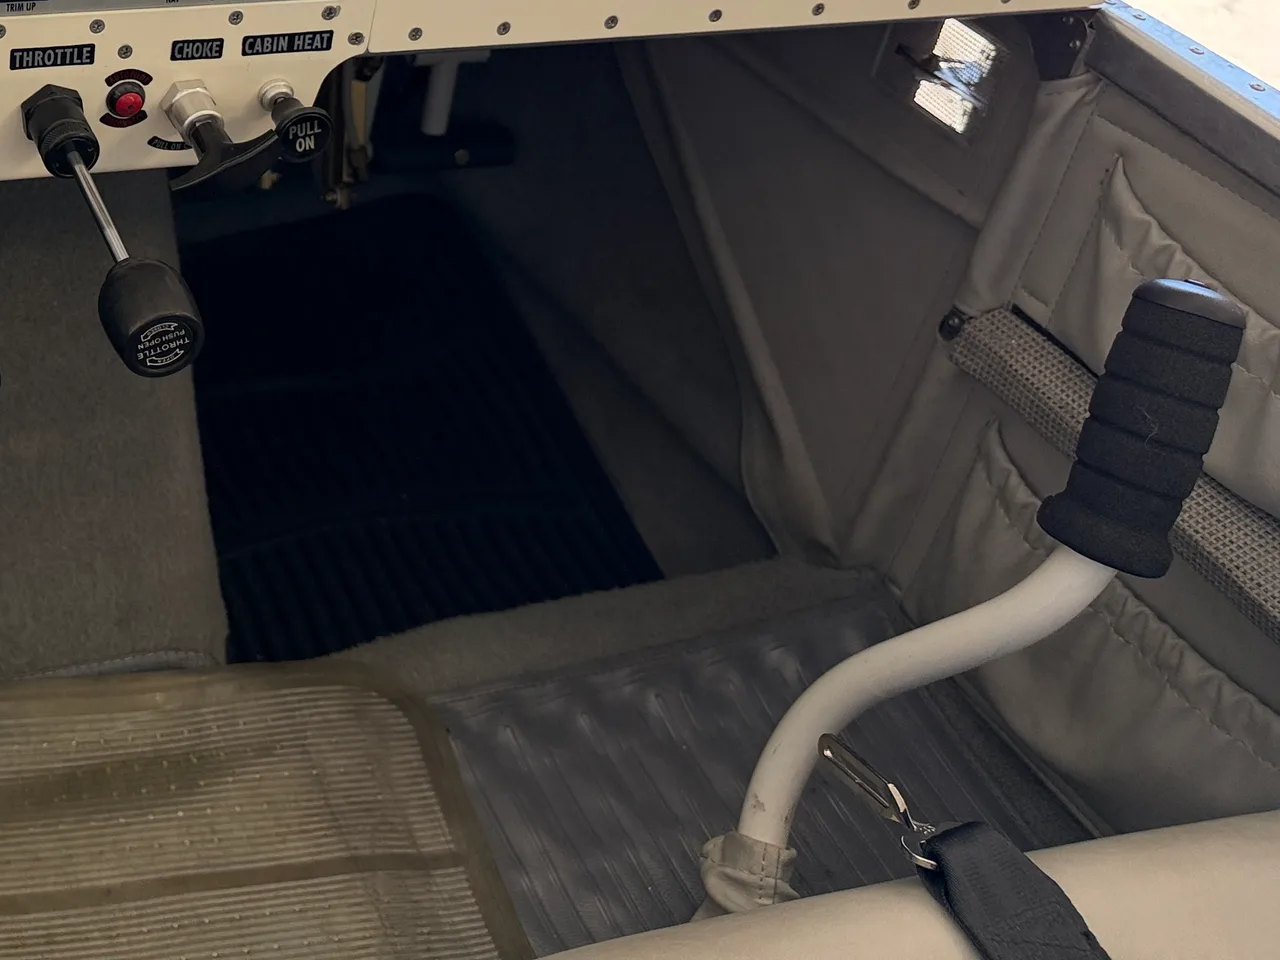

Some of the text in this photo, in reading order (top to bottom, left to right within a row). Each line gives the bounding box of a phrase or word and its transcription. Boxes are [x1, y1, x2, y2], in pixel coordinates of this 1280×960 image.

[6, 2, 36, 13] TRIM UP
[174, 42, 221, 59] CHOKE
[244, 33, 331, 54] CABIN HEAT
[14, 47, 91, 68] THROTTLE
[288, 120, 322, 139] PULL
[151, 139, 169, 148] PULL
[296, 137, 315, 153] ON
[137, 329, 185, 350] PUSH OPEN
[137, 337, 190, 360] THROTTLE
